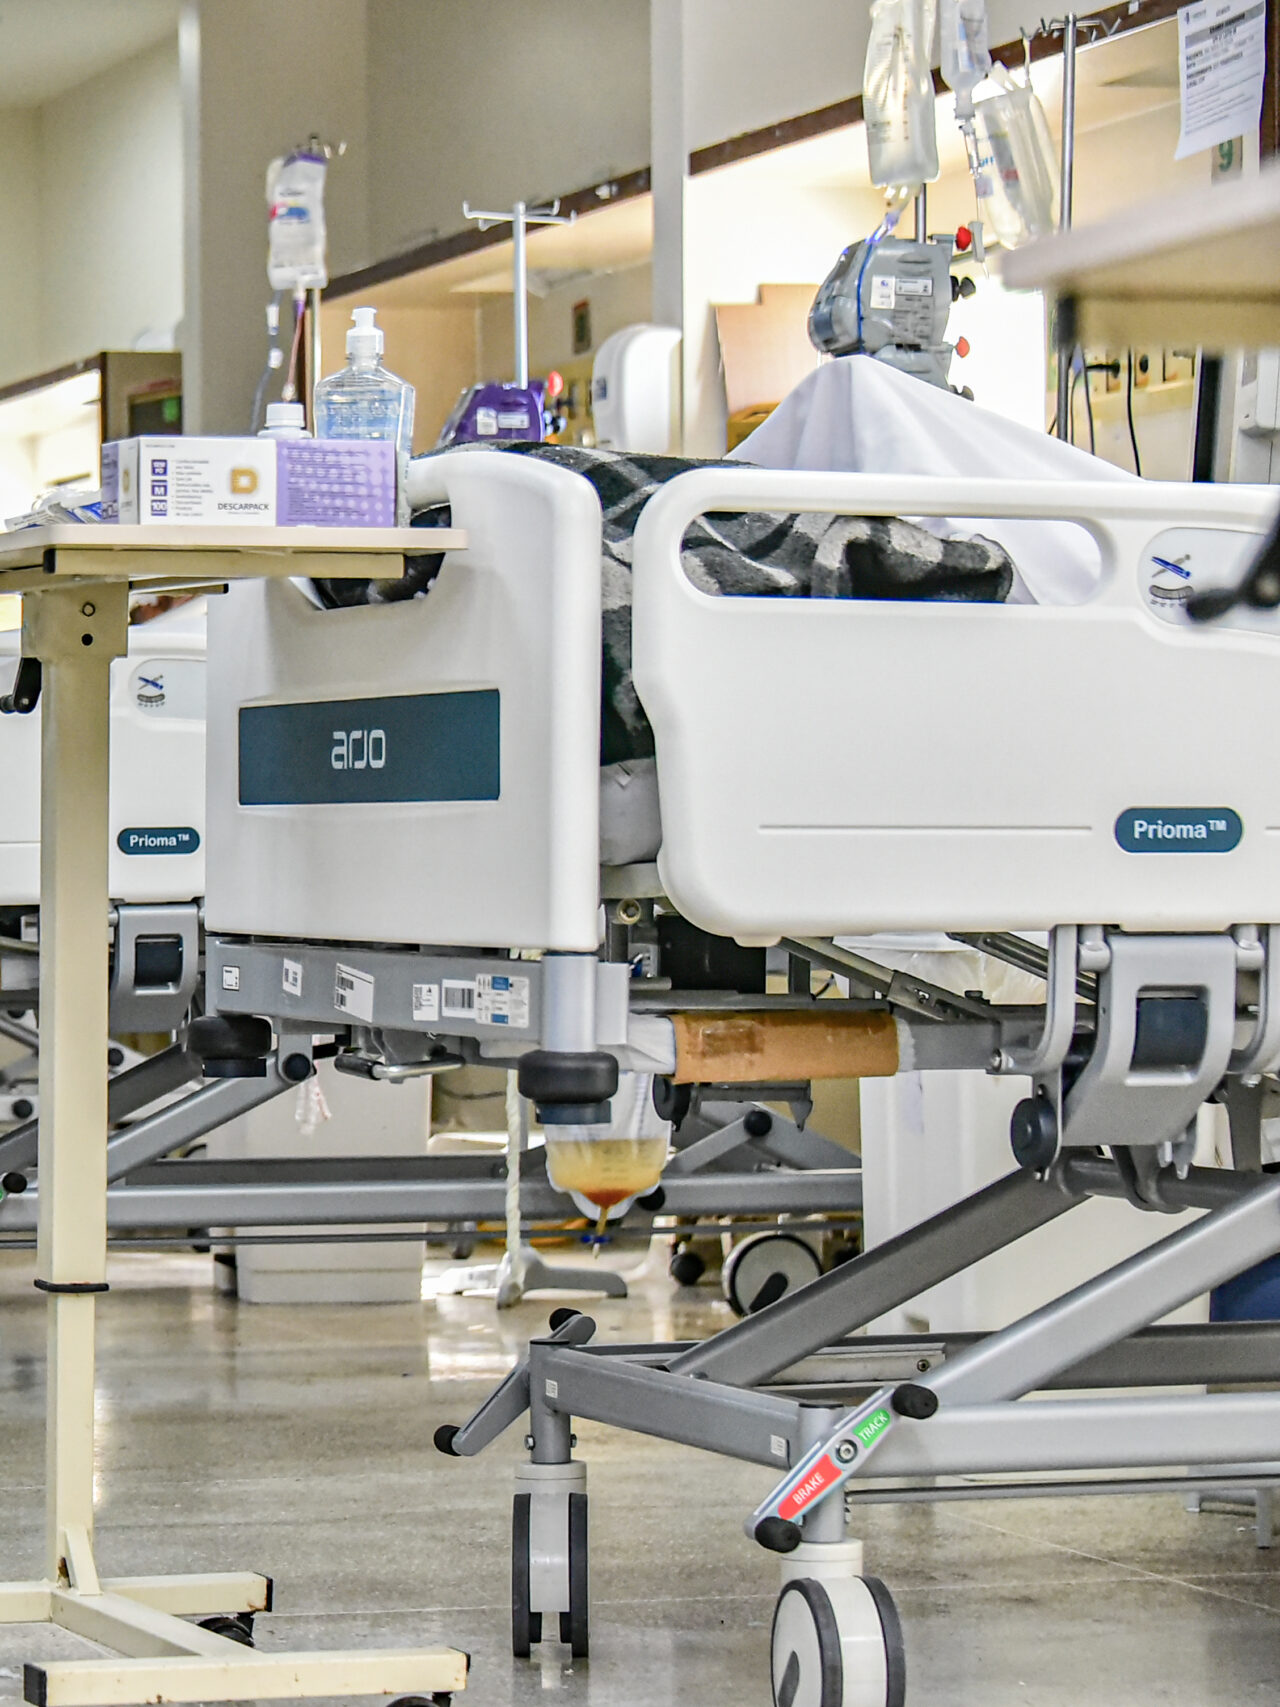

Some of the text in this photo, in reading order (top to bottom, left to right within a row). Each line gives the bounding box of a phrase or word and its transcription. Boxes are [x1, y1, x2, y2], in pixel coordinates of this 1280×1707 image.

[154, 486, 165, 496] M
[151, 501, 168, 512] 100
[217, 502, 270, 511] DESCARPACK
[857, 1412, 888, 1442] TRACK
[792, 1471, 826, 1505] BRAKE
